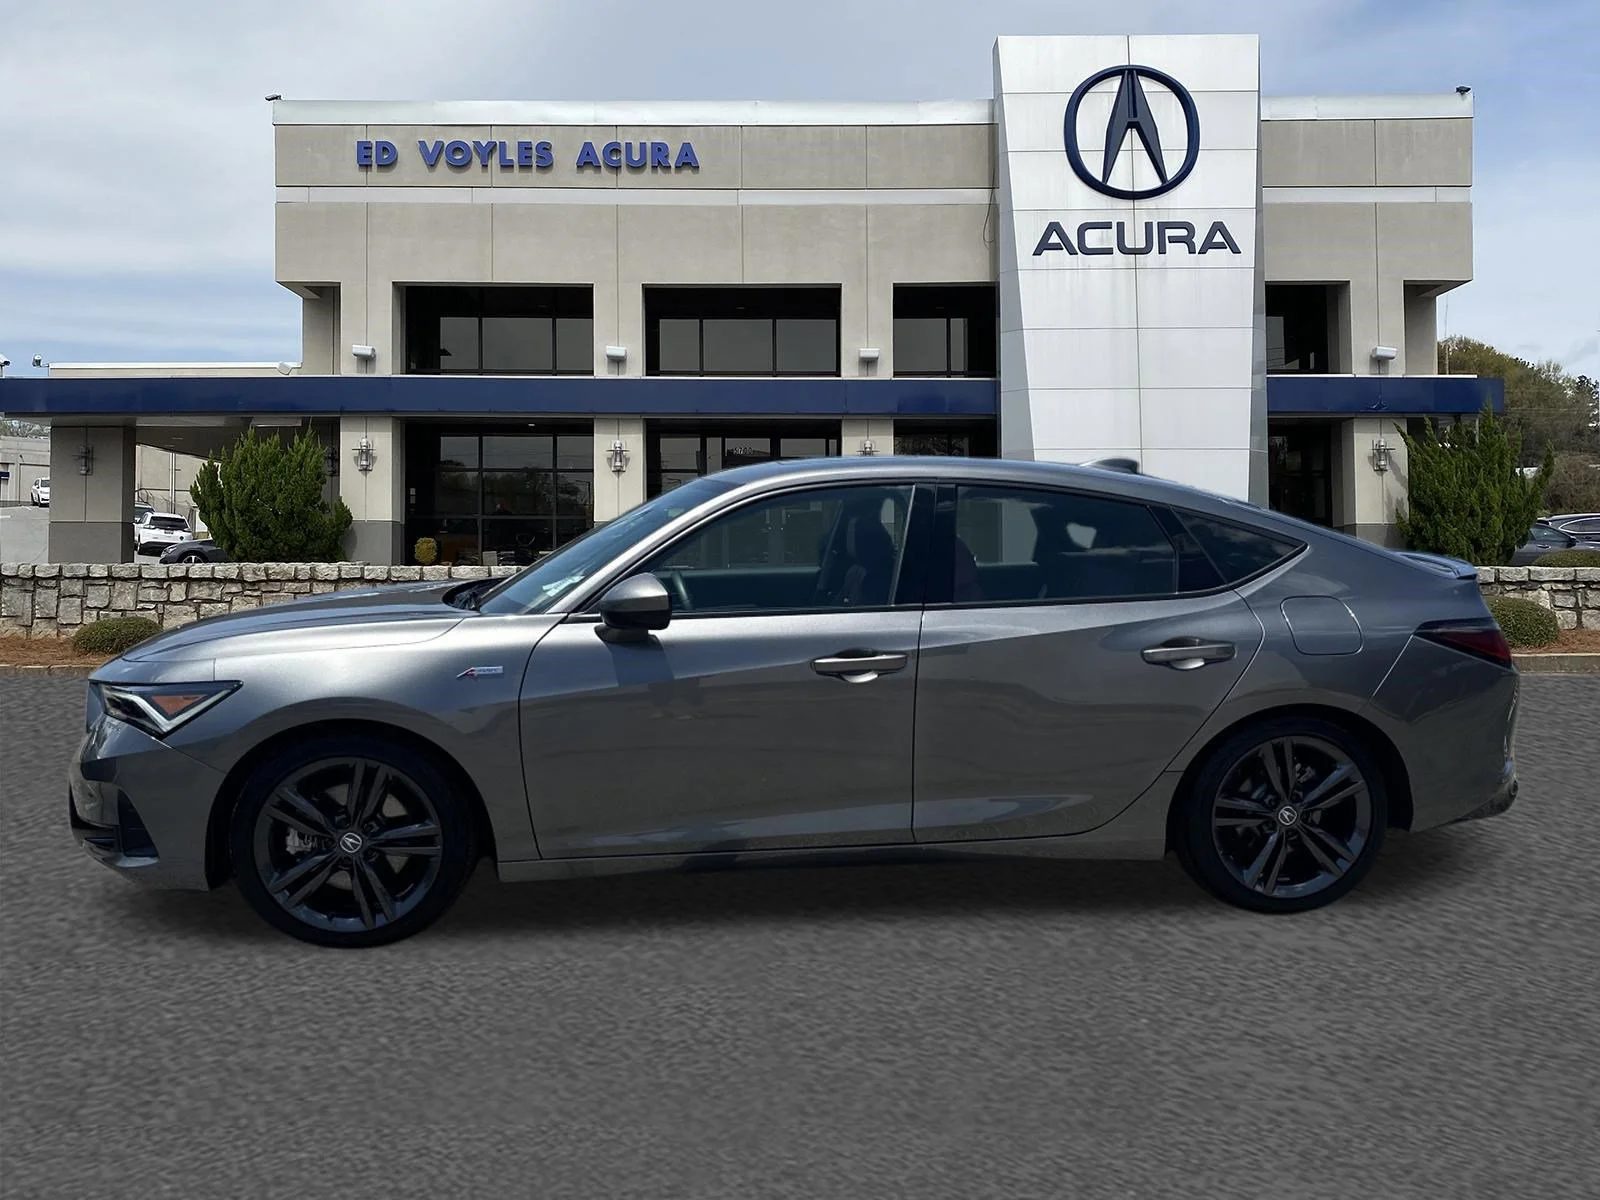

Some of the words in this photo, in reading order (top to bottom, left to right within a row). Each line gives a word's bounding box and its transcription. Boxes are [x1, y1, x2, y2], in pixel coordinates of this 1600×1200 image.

[356, 140, 398, 167] ED
[418, 140, 554, 168] VOYLES
[576, 141, 700, 168] ACURA
[1032, 221, 1242, 256] ACURA
